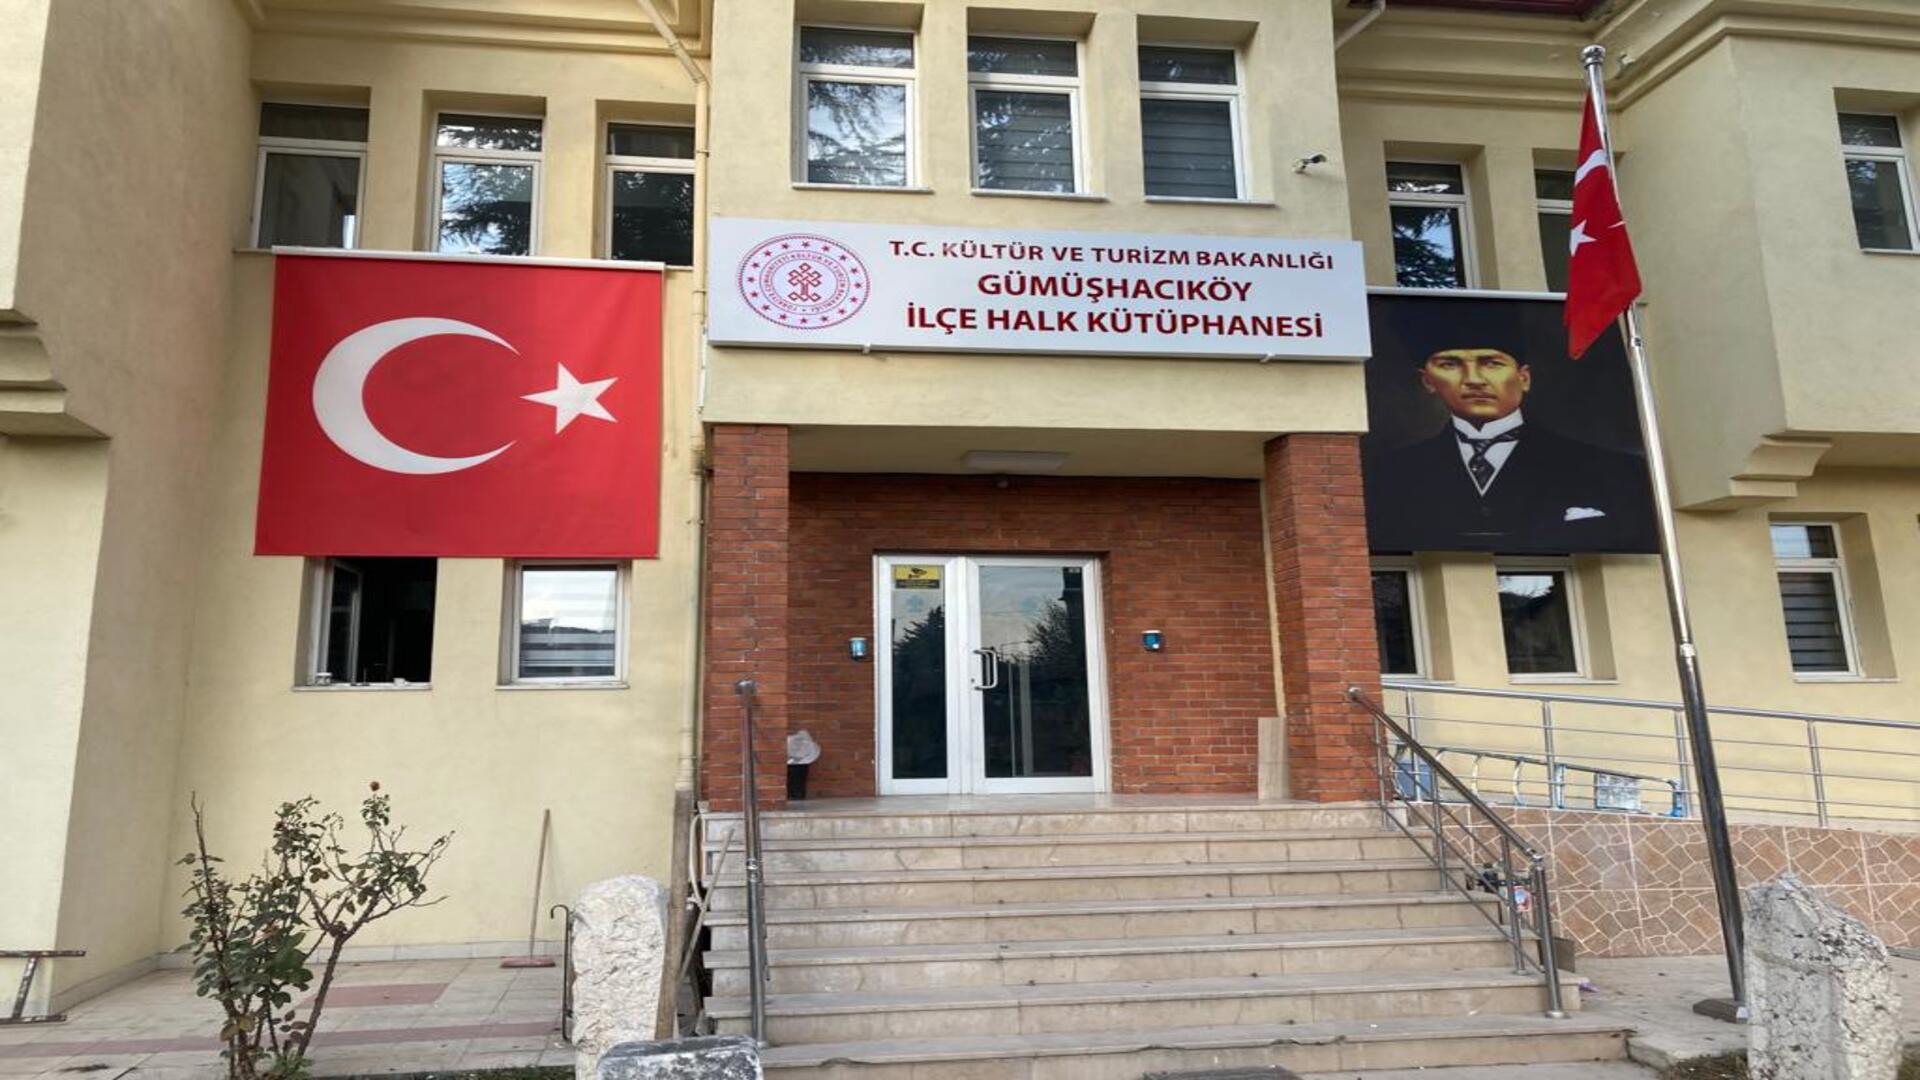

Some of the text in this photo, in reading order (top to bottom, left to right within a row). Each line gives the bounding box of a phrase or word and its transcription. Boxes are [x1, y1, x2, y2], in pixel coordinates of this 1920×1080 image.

[889, 239, 1334, 270] T.C. KÜLTÜR VE TURİZM BAKANLIĞI
[977, 269, 1253, 304] GÜMÜŞHACIKÖY
[907, 301, 1323, 339] İLÇE HALK KÜTÜPHANESİ
